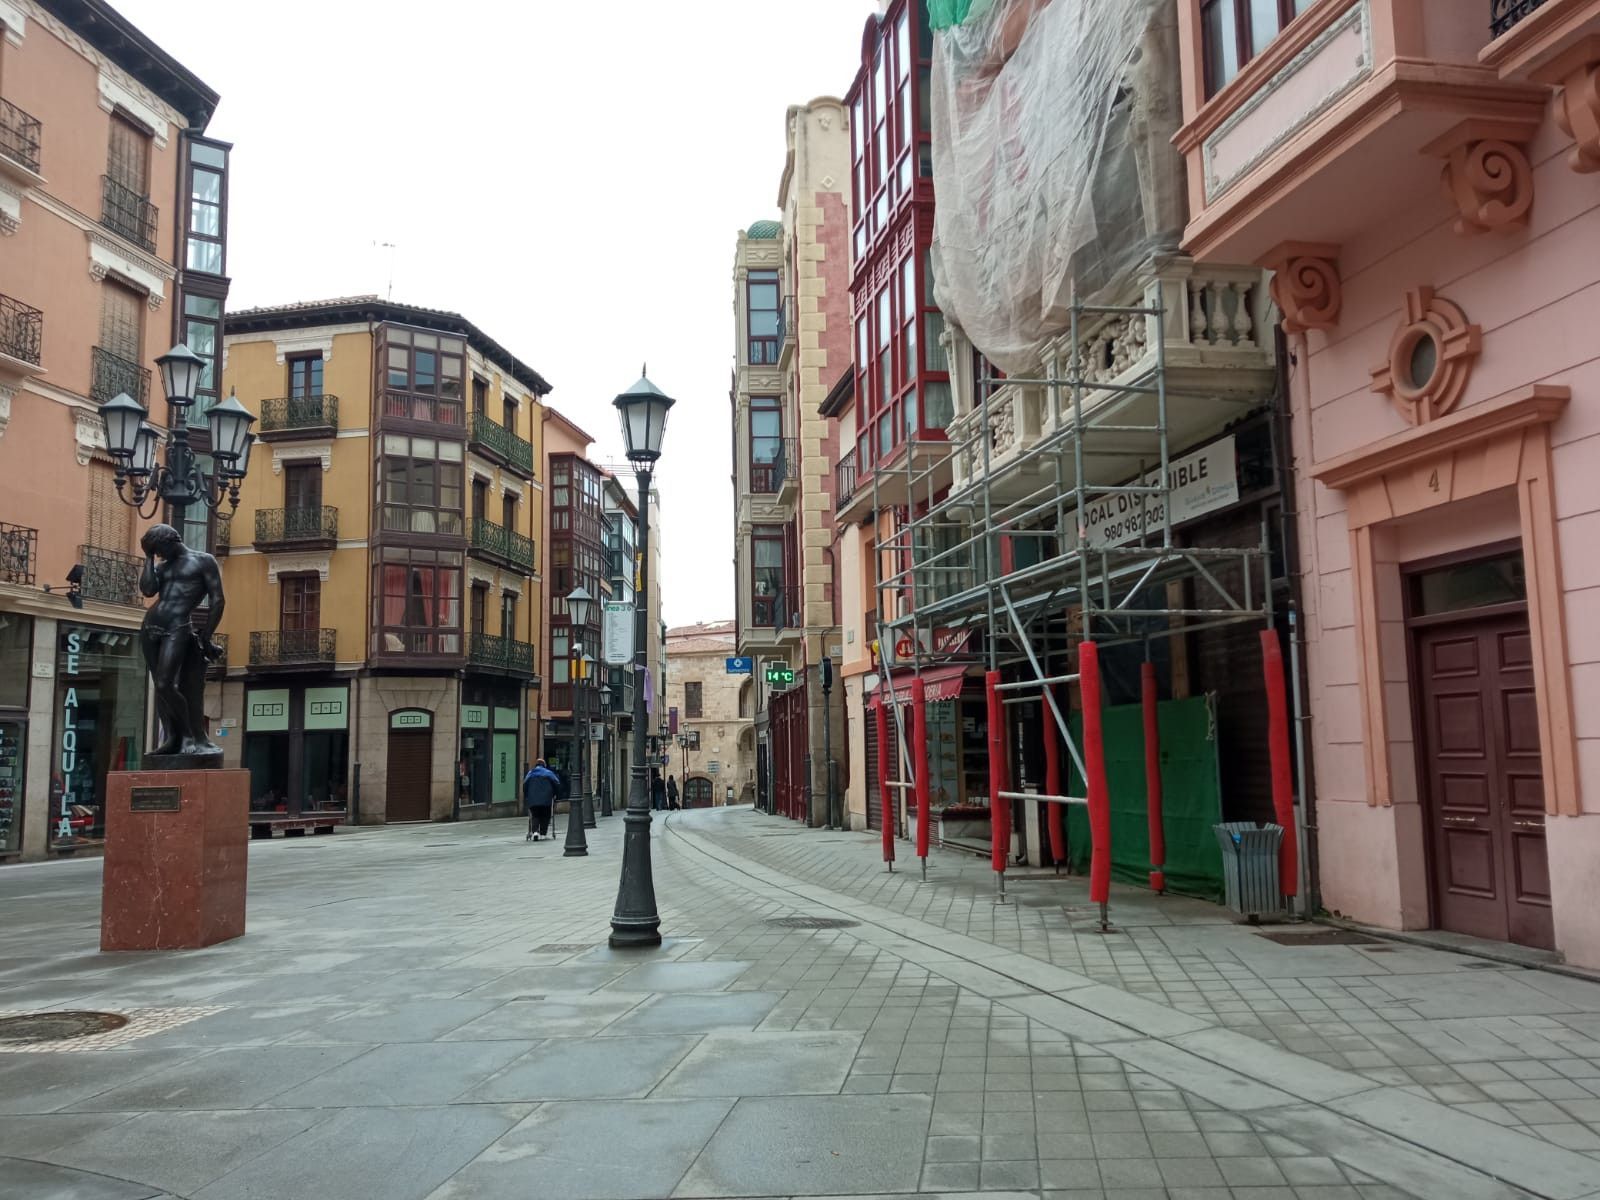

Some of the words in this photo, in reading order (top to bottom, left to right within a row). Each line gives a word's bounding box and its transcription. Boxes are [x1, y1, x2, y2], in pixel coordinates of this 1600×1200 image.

[1118, 457, 1208, 513] DISOIBLE
[1428, 468, 1440, 492] 4
[1104, 522, 1122, 542] 980
[1145, 503, 1165, 526] 303
[67, 633, 80, 674] SE
[767, 671, 779, 681] 14
[58, 687, 79, 837] ALQUILA
